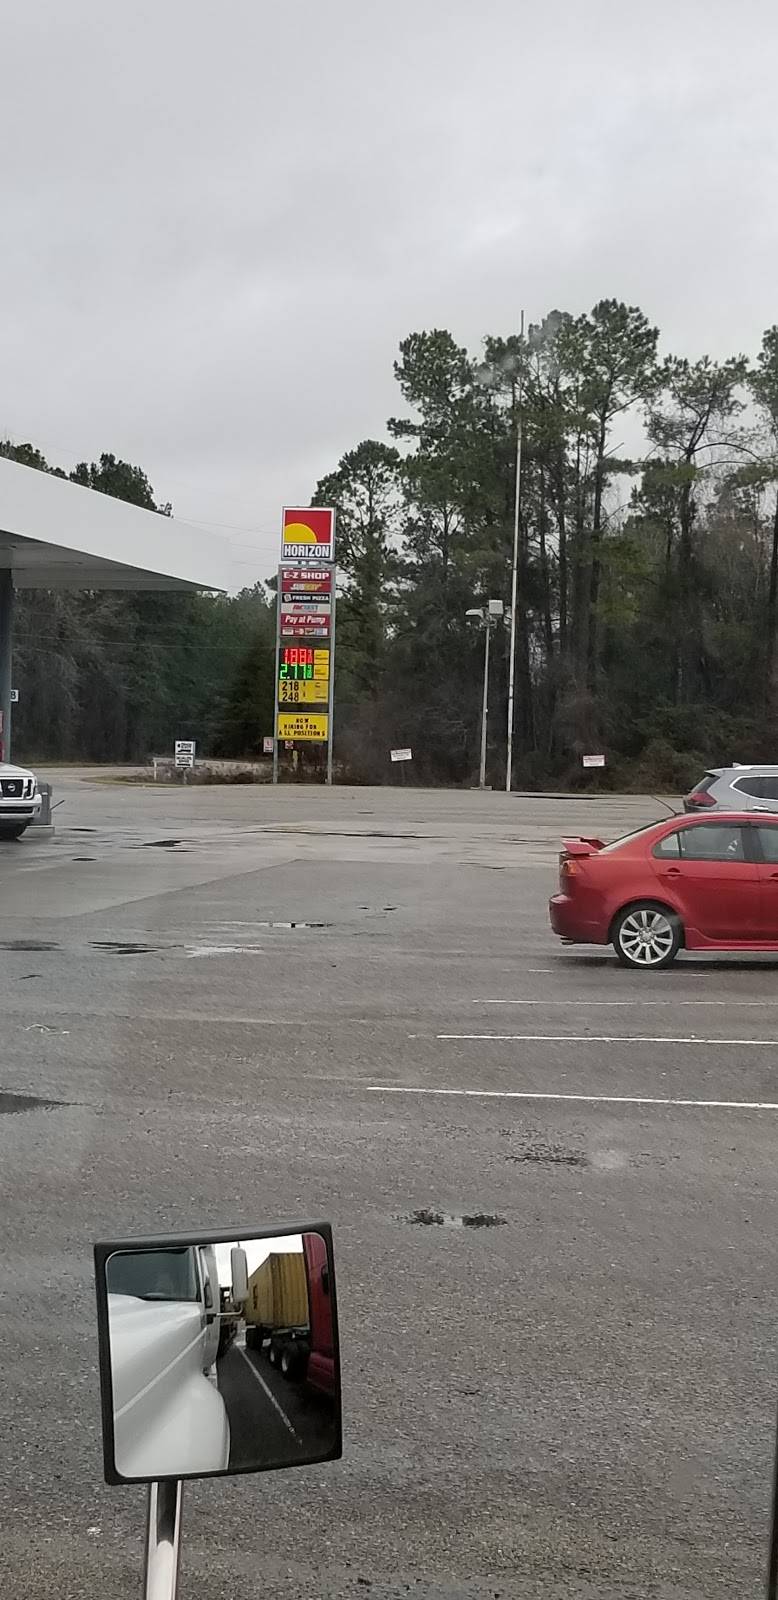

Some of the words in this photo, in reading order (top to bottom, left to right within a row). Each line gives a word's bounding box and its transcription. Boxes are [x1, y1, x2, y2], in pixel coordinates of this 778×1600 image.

[284, 545, 330, 557] HORIZON
[283, 571, 299, 579] E-Z
[300, 572, 330, 580] SHOP
[290, 583, 322, 591] SUBWAY
[285, 615, 298, 625] Pay
[306, 616, 326, 625] Pump
[281, 681, 300, 691] 218
[282, 692, 300, 702] 248
